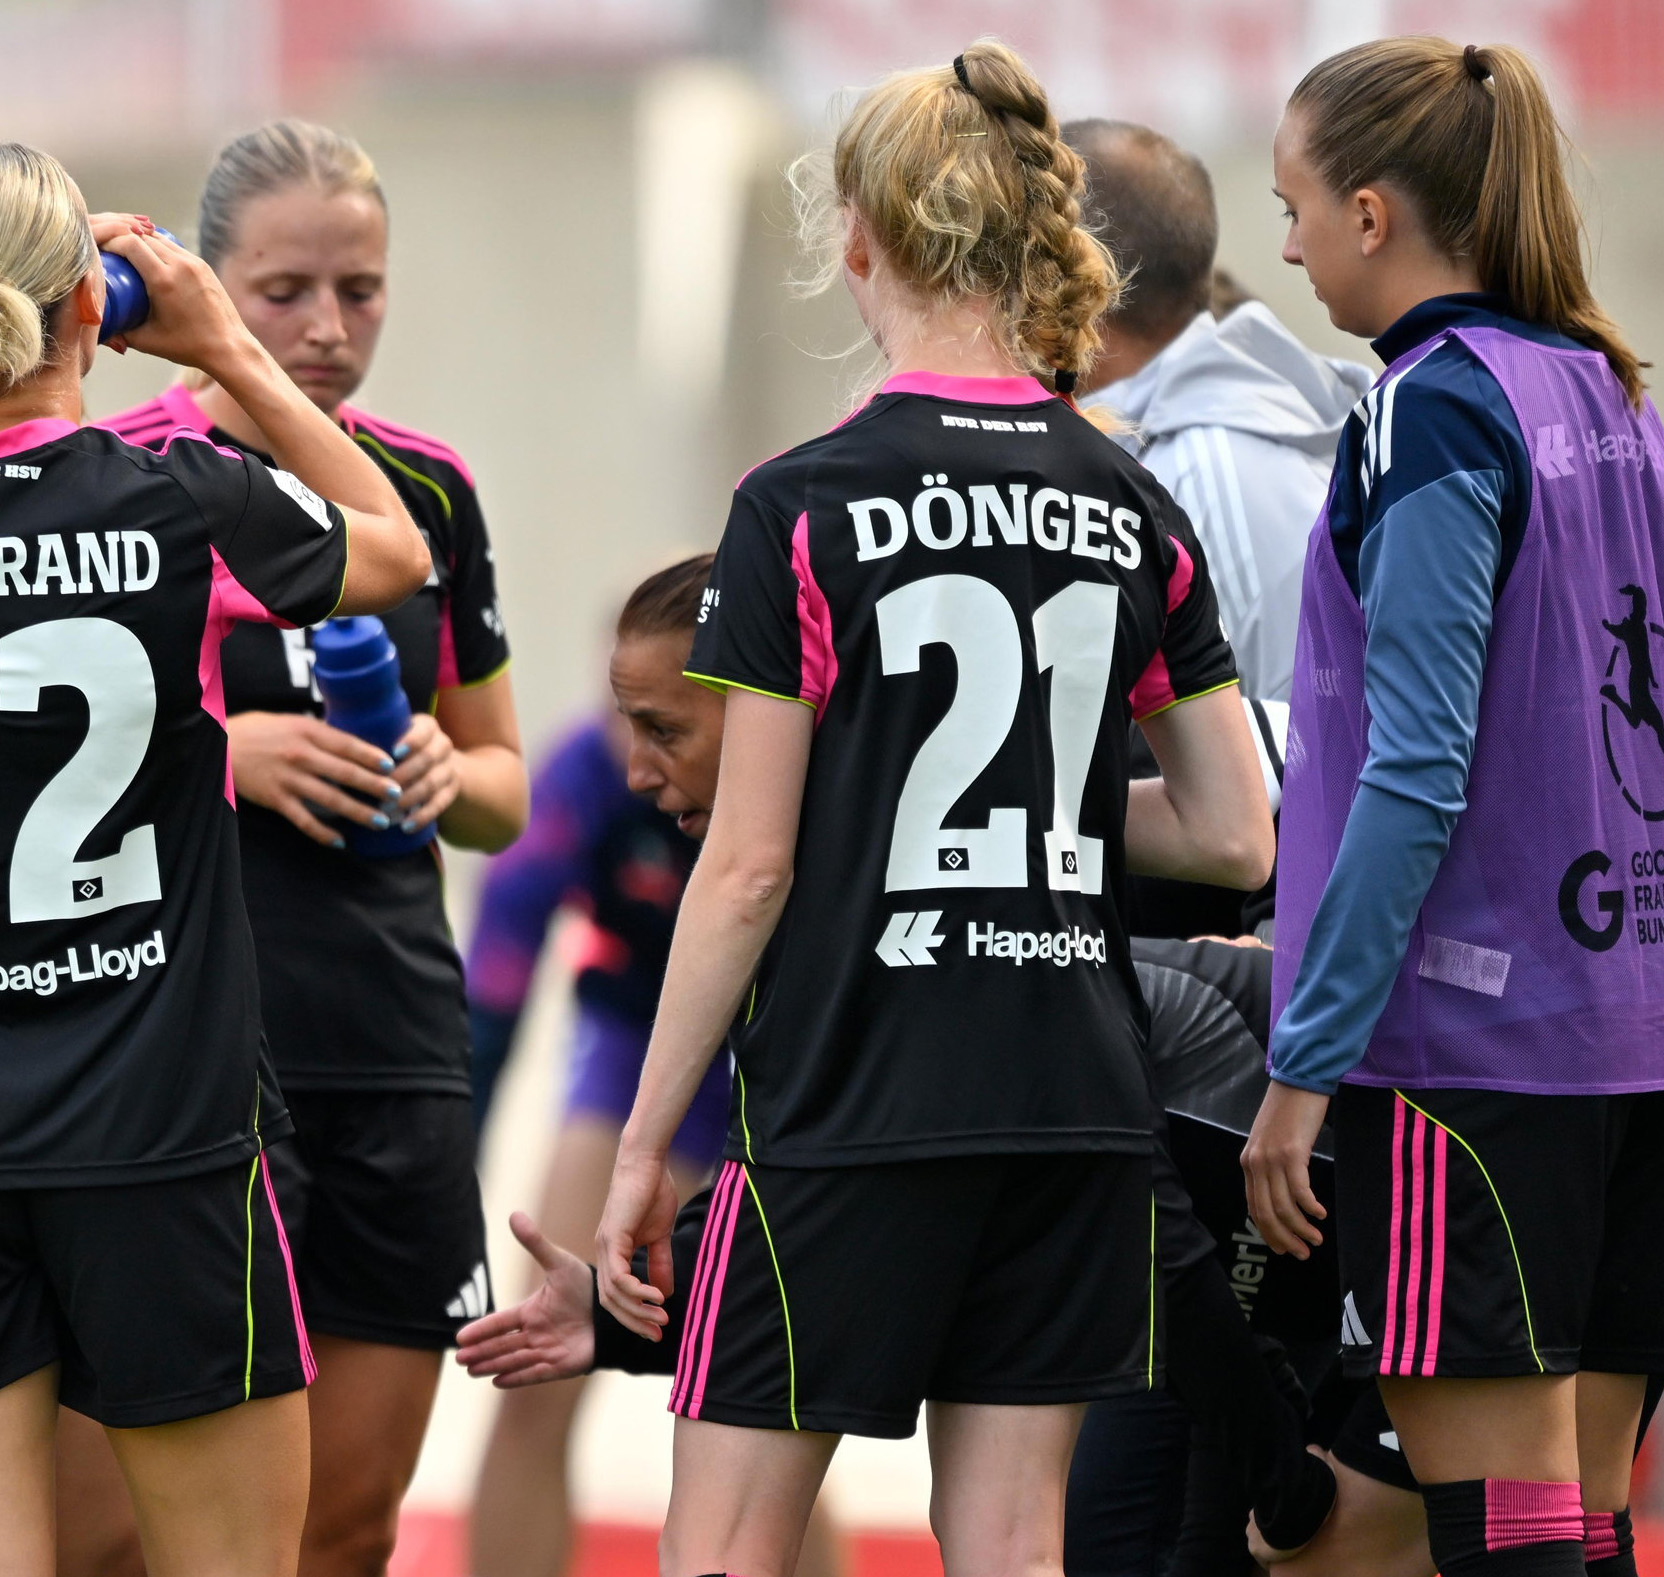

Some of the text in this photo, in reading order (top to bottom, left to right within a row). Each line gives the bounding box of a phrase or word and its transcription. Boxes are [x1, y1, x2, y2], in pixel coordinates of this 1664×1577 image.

[940, 414, 1048, 433] NUR DER HSV
[4, 464, 42, 480] HSV
[847, 474, 1142, 570] DÖNGES
[876, 574, 1119, 895] 21
[1558, 850, 1624, 953] G
[1634, 883, 1664, 912] FRA
